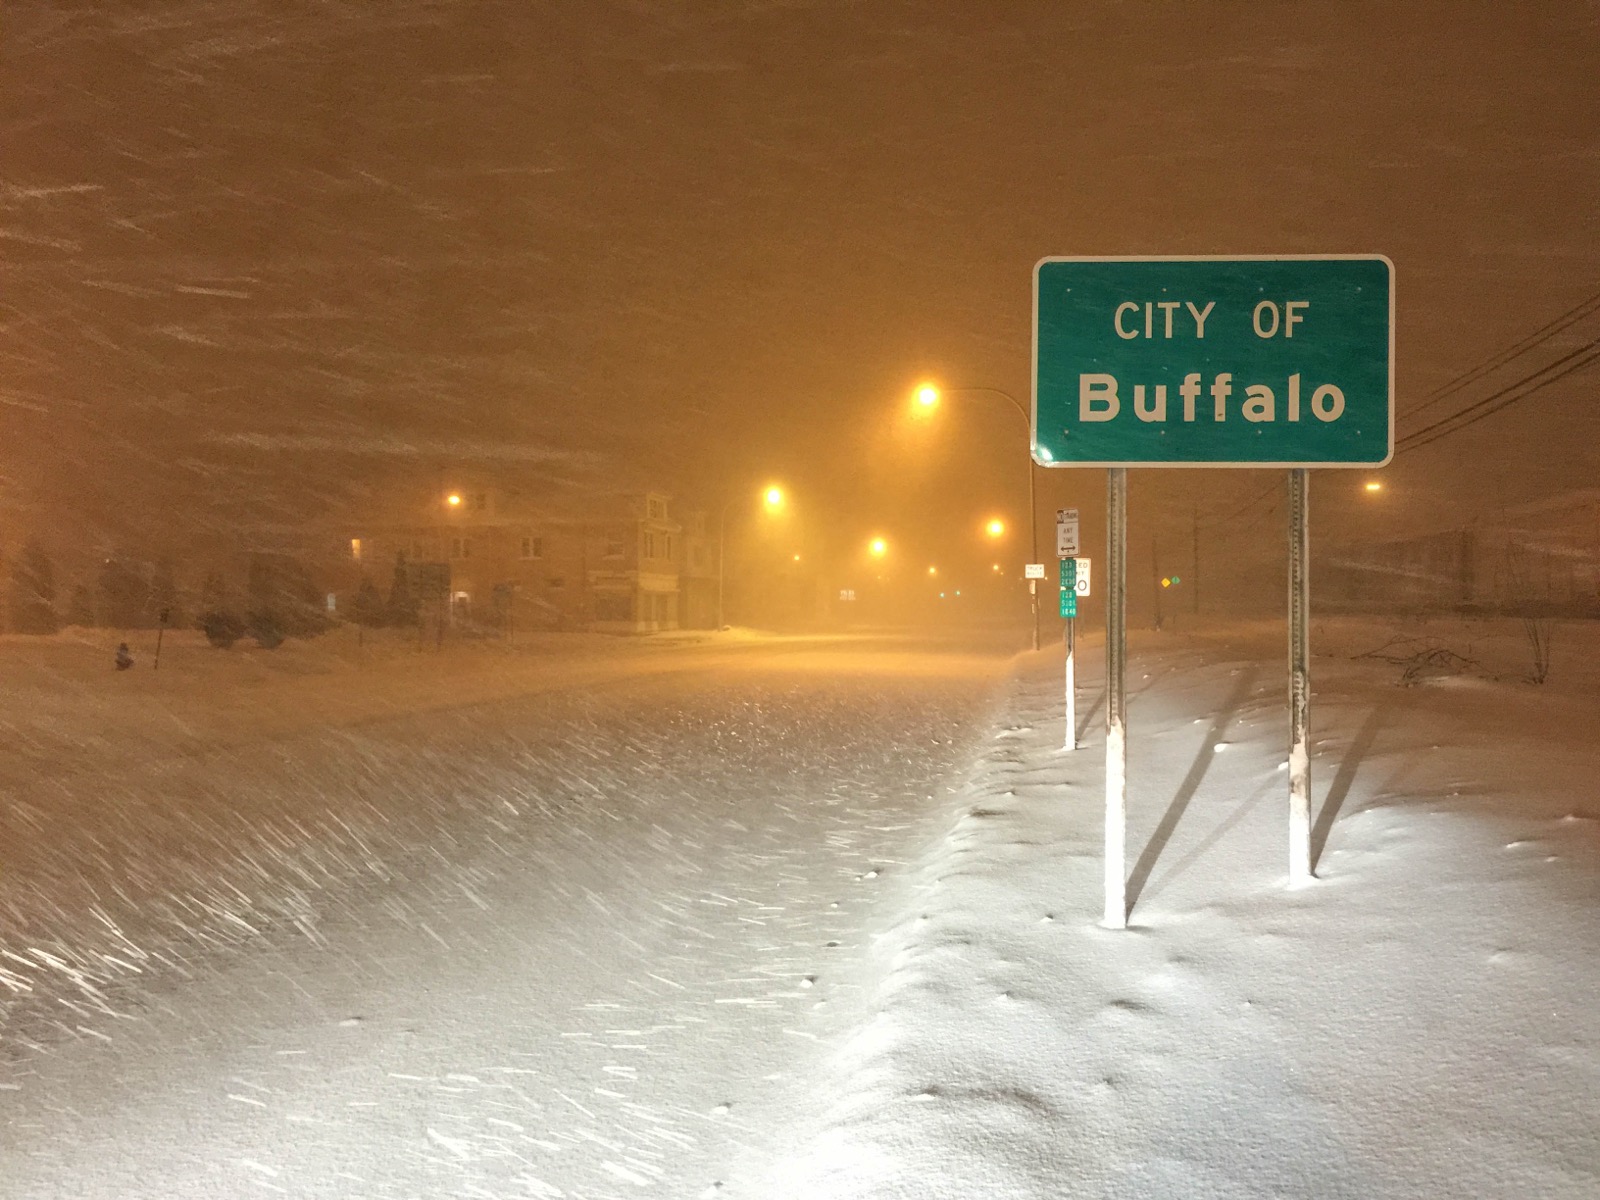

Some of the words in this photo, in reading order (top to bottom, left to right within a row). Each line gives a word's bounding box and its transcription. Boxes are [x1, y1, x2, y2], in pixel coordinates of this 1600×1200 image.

[1115, 301, 1217, 340] CITY
[1252, 300, 1310, 339] OF
[1079, 373, 1347, 423] Buffalo
